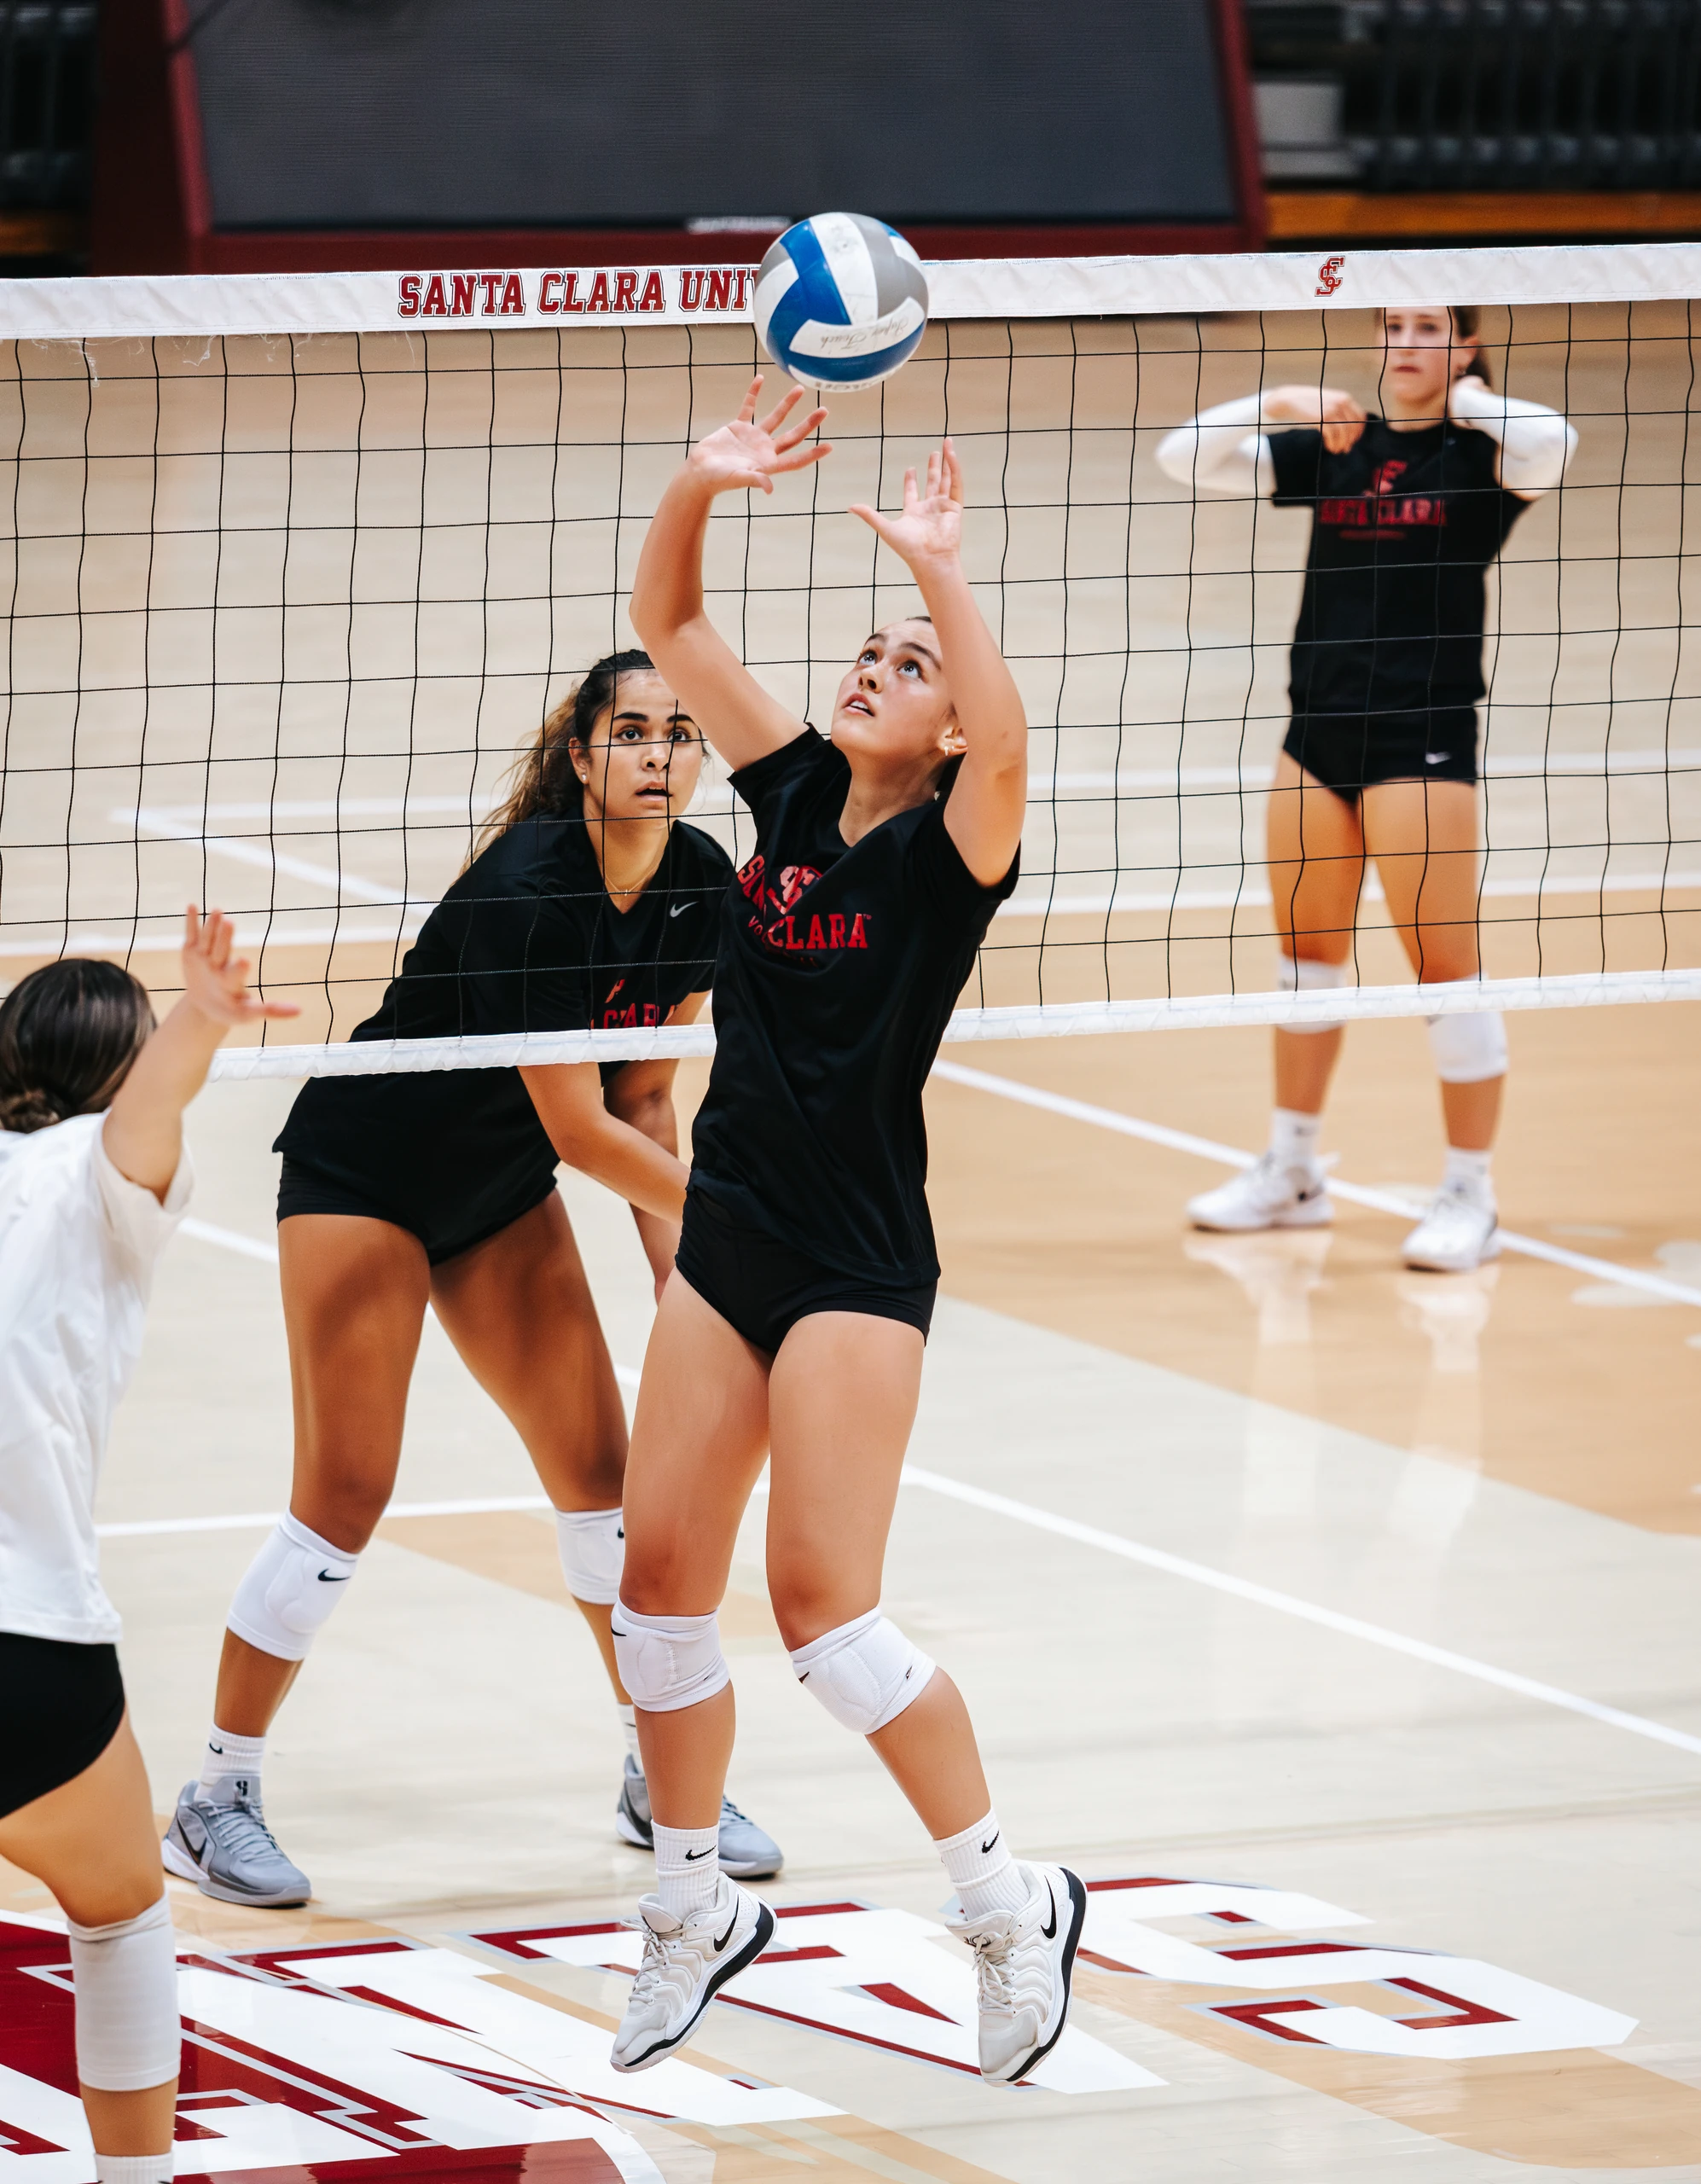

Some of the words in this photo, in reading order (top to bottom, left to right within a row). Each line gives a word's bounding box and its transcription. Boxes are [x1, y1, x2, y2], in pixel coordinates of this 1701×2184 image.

[398, 271, 526, 317] SANTA
[537, 269, 666, 315] CLARA
[820, 332, 868, 350] Touch
[768, 913, 868, 950] CLARA
